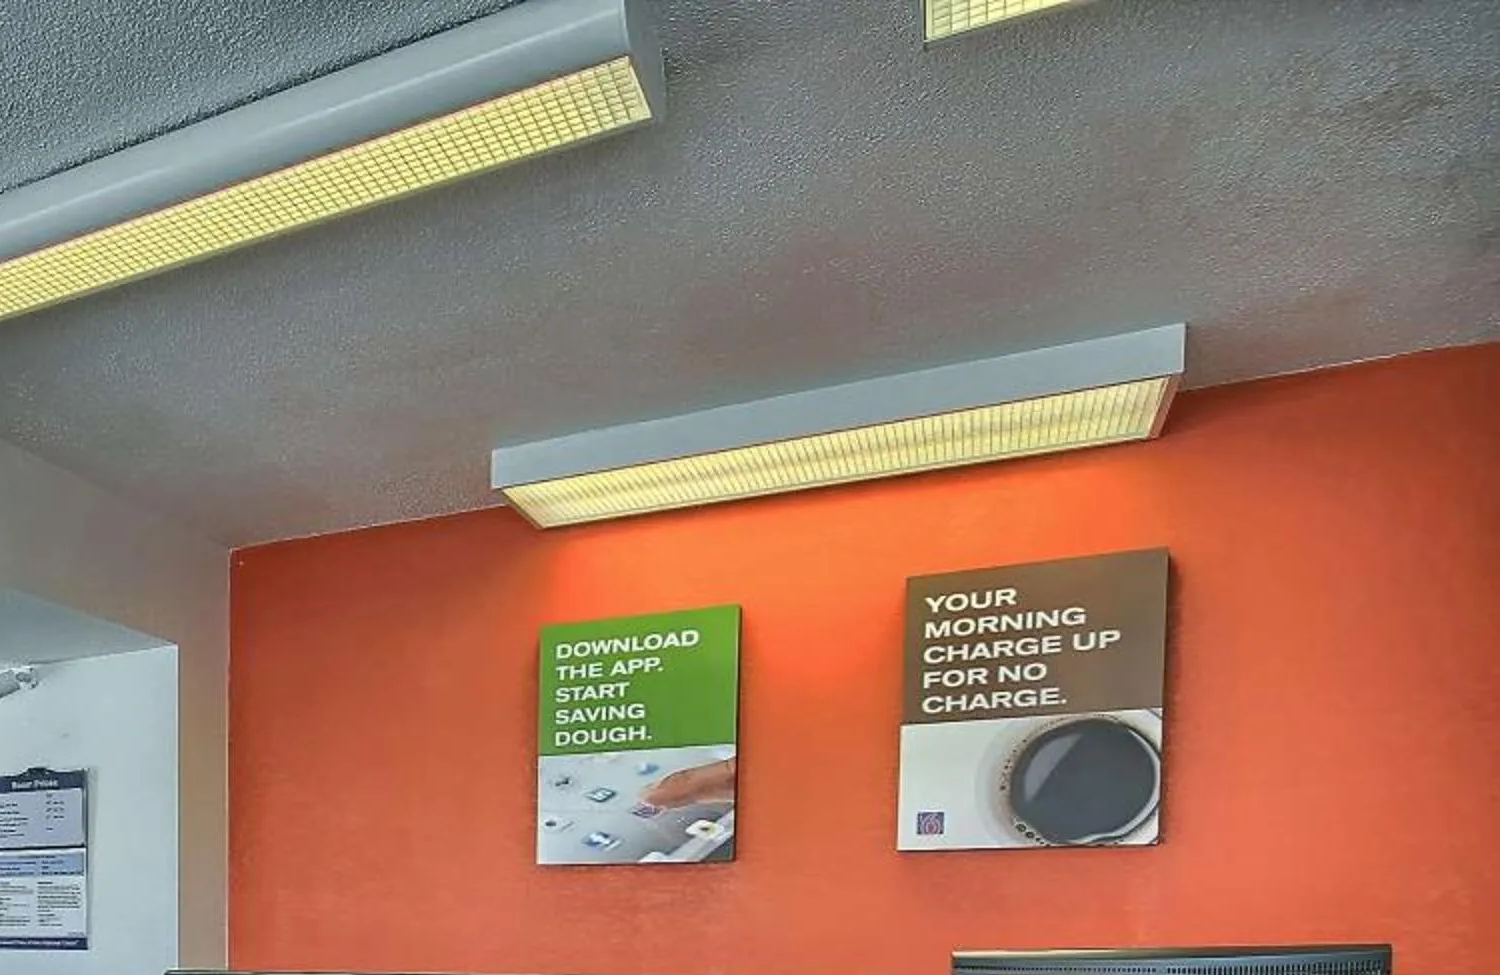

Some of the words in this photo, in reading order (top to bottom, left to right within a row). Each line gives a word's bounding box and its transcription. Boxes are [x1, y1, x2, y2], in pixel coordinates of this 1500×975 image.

[925, 588, 1017, 613] YOUR
[924, 607, 1087, 639] MORNING
[556, 630, 699, 659] DOWNLOAD
[923, 635, 1063, 665] CHARGE
[1073, 629, 1121, 651] UP
[556, 662, 603, 681] THE
[610, 657, 664, 677] APP.
[923, 667, 989, 689] FOR
[998, 662, 1047, 683] NO
[556, 682, 630, 703] START
[921, 687, 1068, 714] CHARGE.
[555, 703, 645, 725] SAVING
[555, 725, 653, 746] DOUGH.
